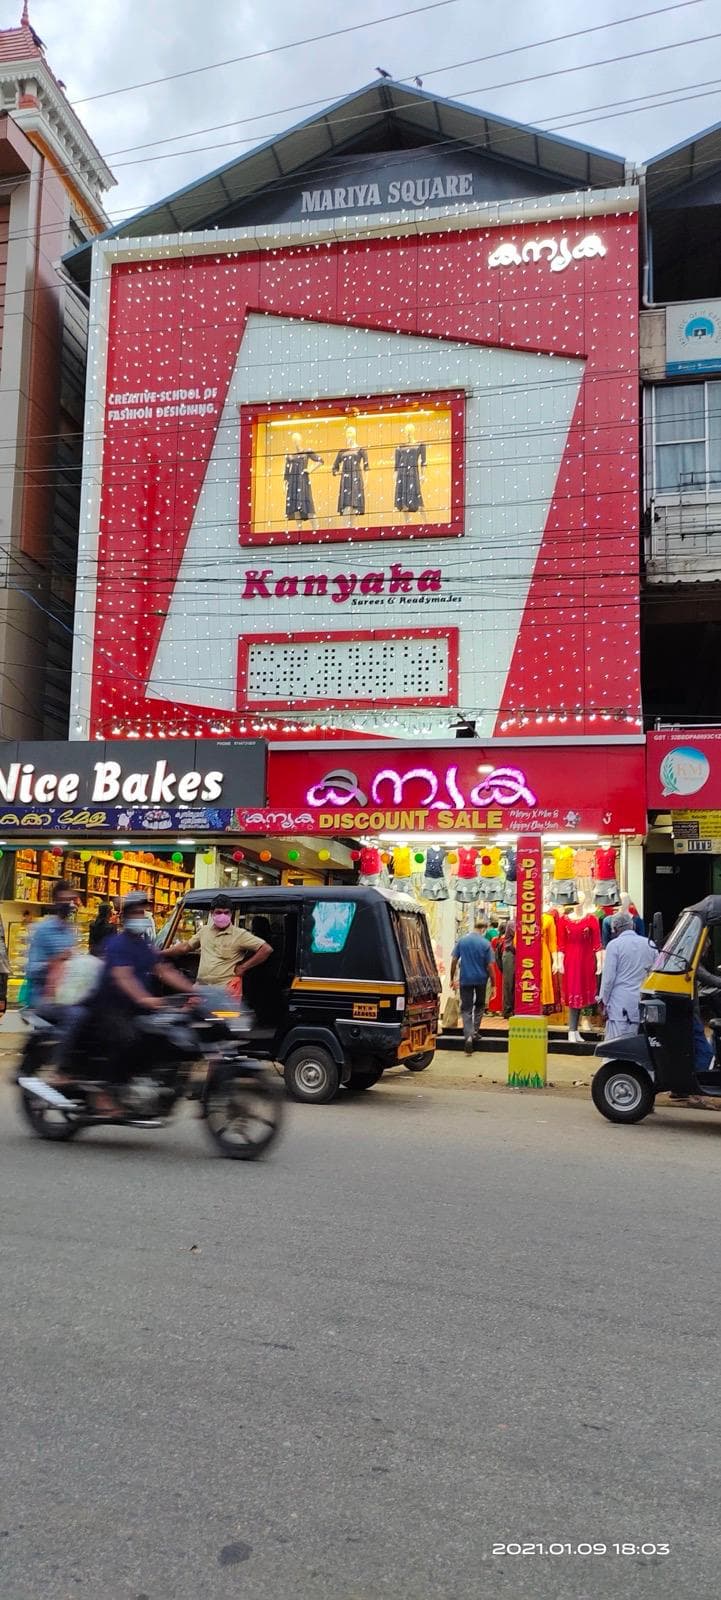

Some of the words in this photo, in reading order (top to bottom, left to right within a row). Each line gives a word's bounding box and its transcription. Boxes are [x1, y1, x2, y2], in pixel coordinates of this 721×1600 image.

[301, 184, 382, 212] MARIYA
[388, 173, 473, 206] SQUARE
[488, 234, 607, 272] കന്യക
[204, 387, 218, 399] OF
[108, 407, 153, 421] FASHION
[241, 563, 442, 603] Kanyaka
[351, 597, 388, 606] Sarees
[0, 762, 80, 804] Nice
[91, 760, 224, 803] Bakes
[306, 765, 538, 810] കന്യക
[246, 812, 315, 829] കന്യക
[319, 810, 429, 830] DISCOUNT
[437, 809, 503, 829] SALE
[521, 858, 536, 946] DISCOUNT
[521, 958, 535, 1003] SALE
